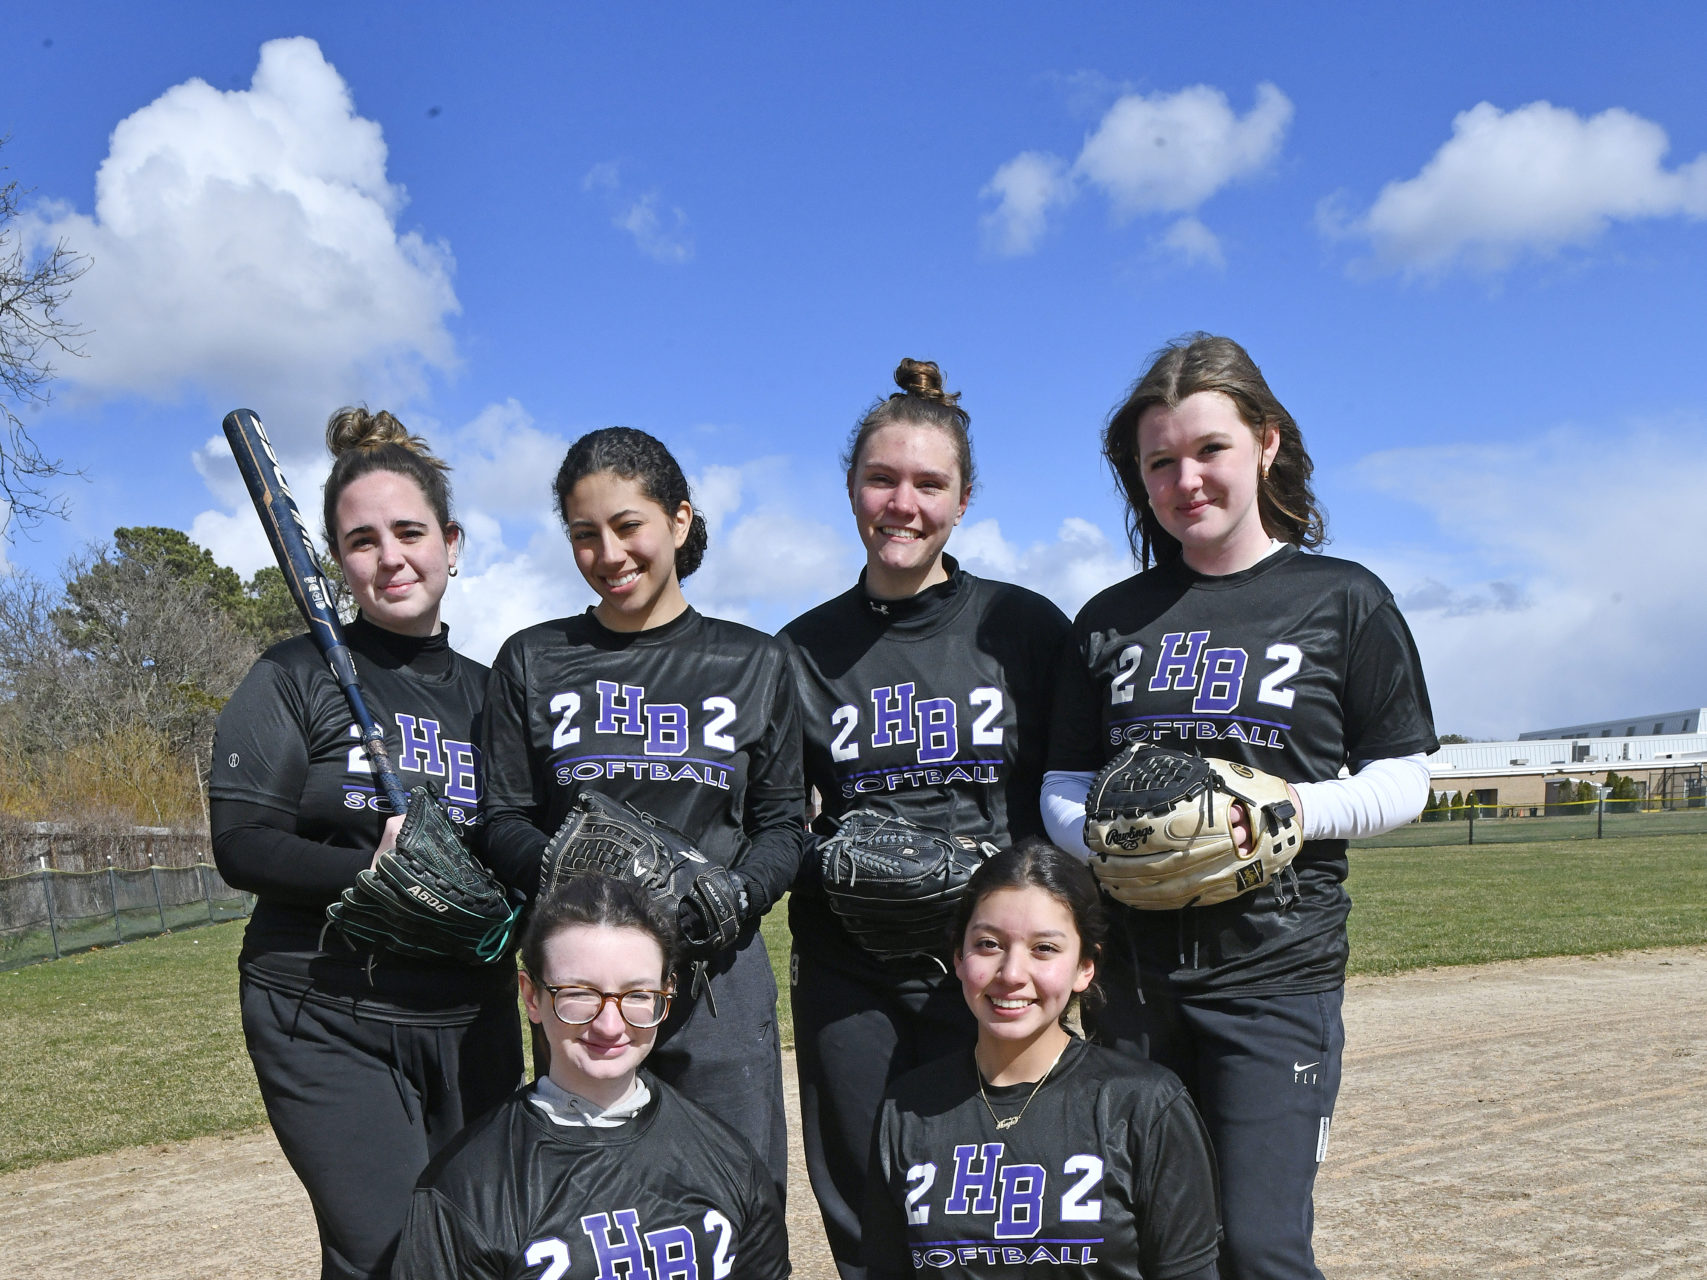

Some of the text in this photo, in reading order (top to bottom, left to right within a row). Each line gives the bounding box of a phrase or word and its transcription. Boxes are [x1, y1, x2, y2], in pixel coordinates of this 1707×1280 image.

[1111, 630, 1304, 714] 2 HB 2
[550, 679, 737, 757] 2 HB 2
[830, 681, 1004, 764] 2 HB 2
[1110, 721, 1285, 750] SOFTBALL
[556, 762, 730, 791] SOFTBALL
[842, 766, 999, 799] SOFTBALL
[1105, 825, 1155, 846] Rawlings
[1294, 1072, 1318, 1085] FLY
[905, 1142, 1104, 1240] 2 HB 2
[912, 1245, 1099, 1269] SOFTBALL
